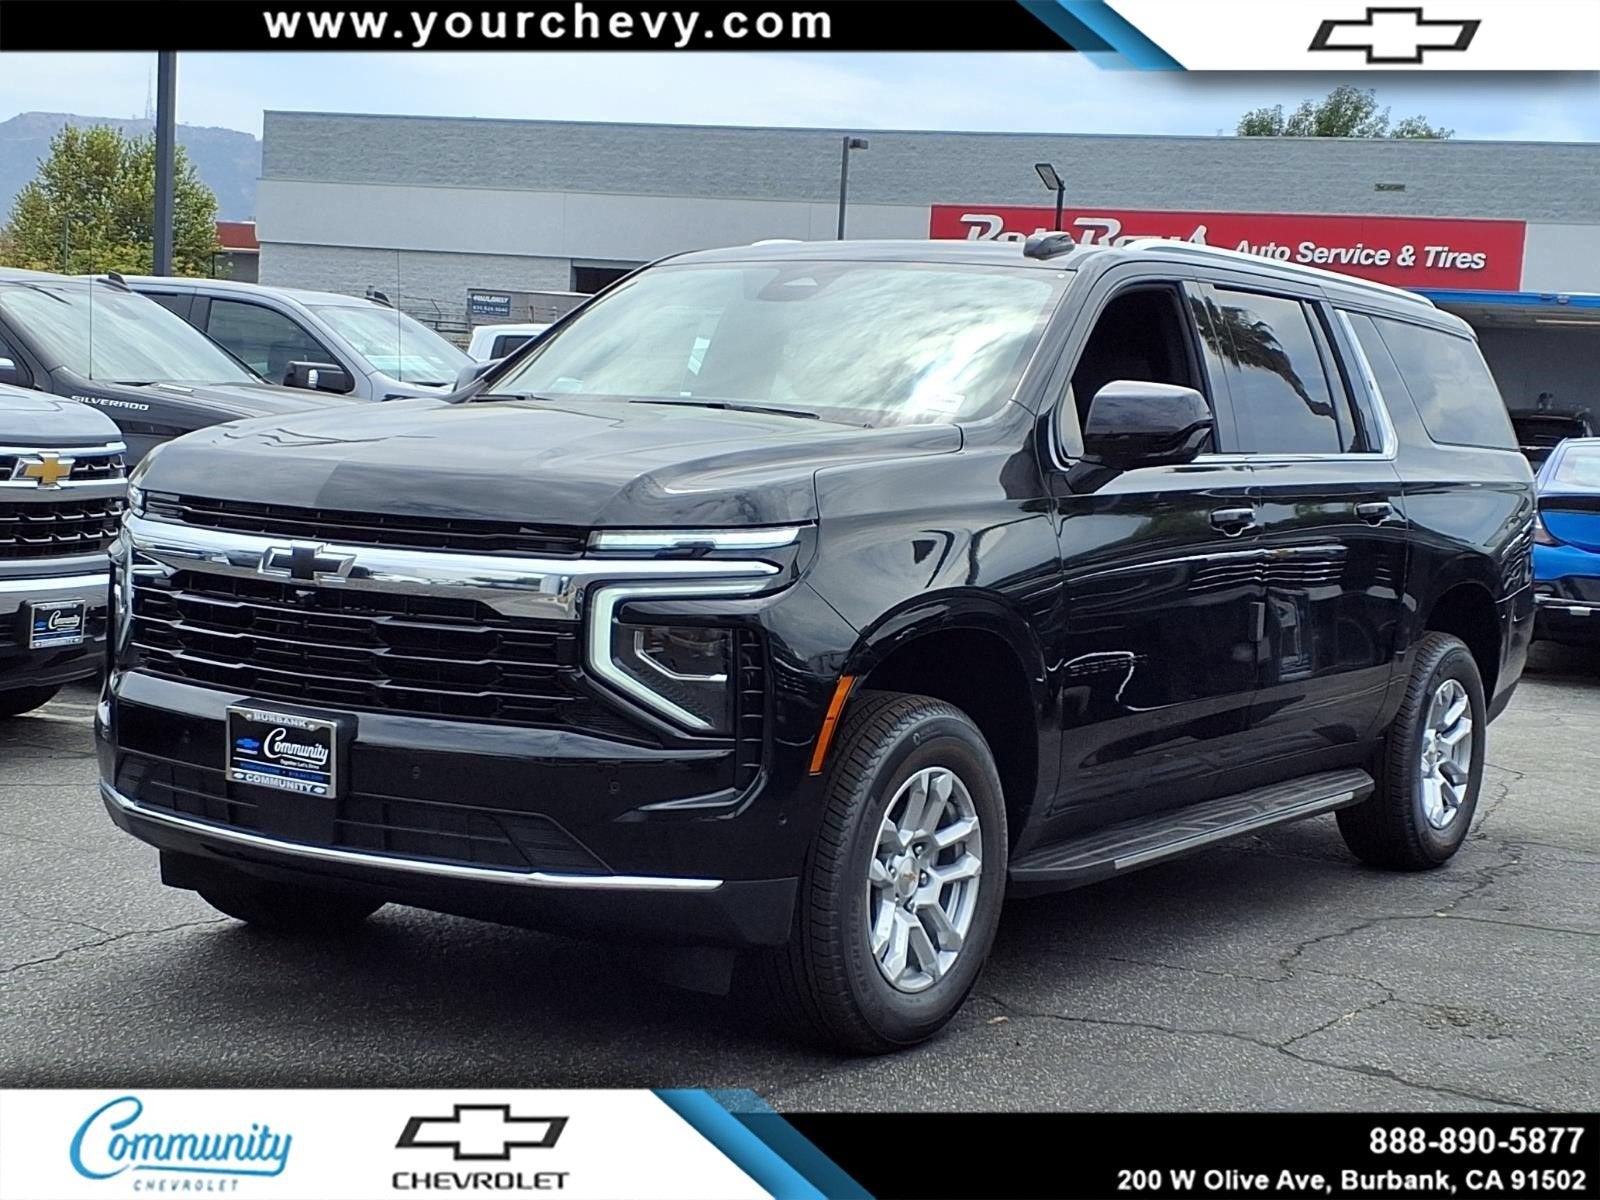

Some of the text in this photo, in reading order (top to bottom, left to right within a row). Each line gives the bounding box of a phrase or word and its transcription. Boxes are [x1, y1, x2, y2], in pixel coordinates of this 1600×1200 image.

[1296, 241, 1391, 266] Service
[1397, 245, 1416, 268] &
[1424, 246, 1487, 270] Tires
[71, 395, 150, 411] SILVERADO
[254, 712, 307, 727] BURBANK
[264, 728, 328, 765] Community
[245, 774, 313, 792] COMMUNITY
